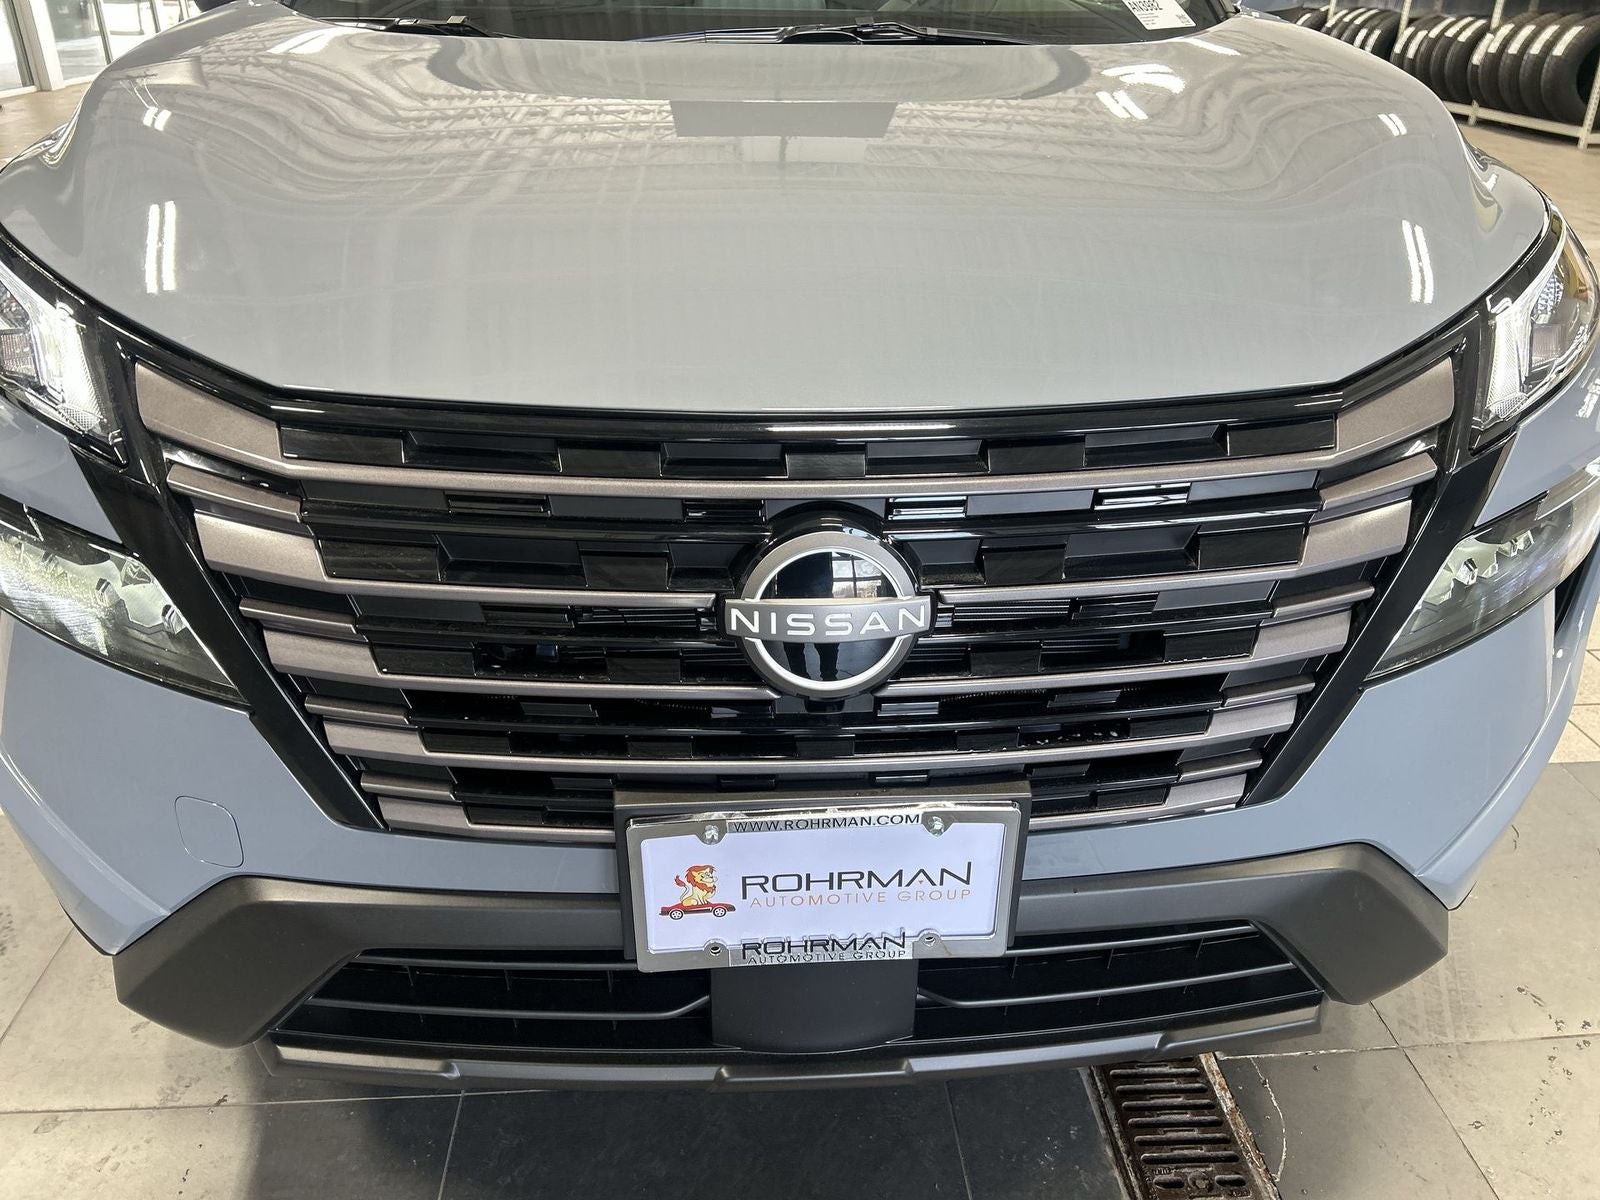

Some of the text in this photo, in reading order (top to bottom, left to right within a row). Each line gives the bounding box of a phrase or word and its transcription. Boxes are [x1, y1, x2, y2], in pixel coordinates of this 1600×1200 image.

[730, 605, 925, 636] NISSAN
[734, 813, 919, 832] WWW.ROHRMAN.COM
[741, 861, 972, 900] ROHRMAN
[749, 889, 972, 908] AUTOMOTIVE GROUP
[741, 931, 906, 960] ROHRMAN
[747, 949, 906, 965] AUTOMOTIVE GROUP
